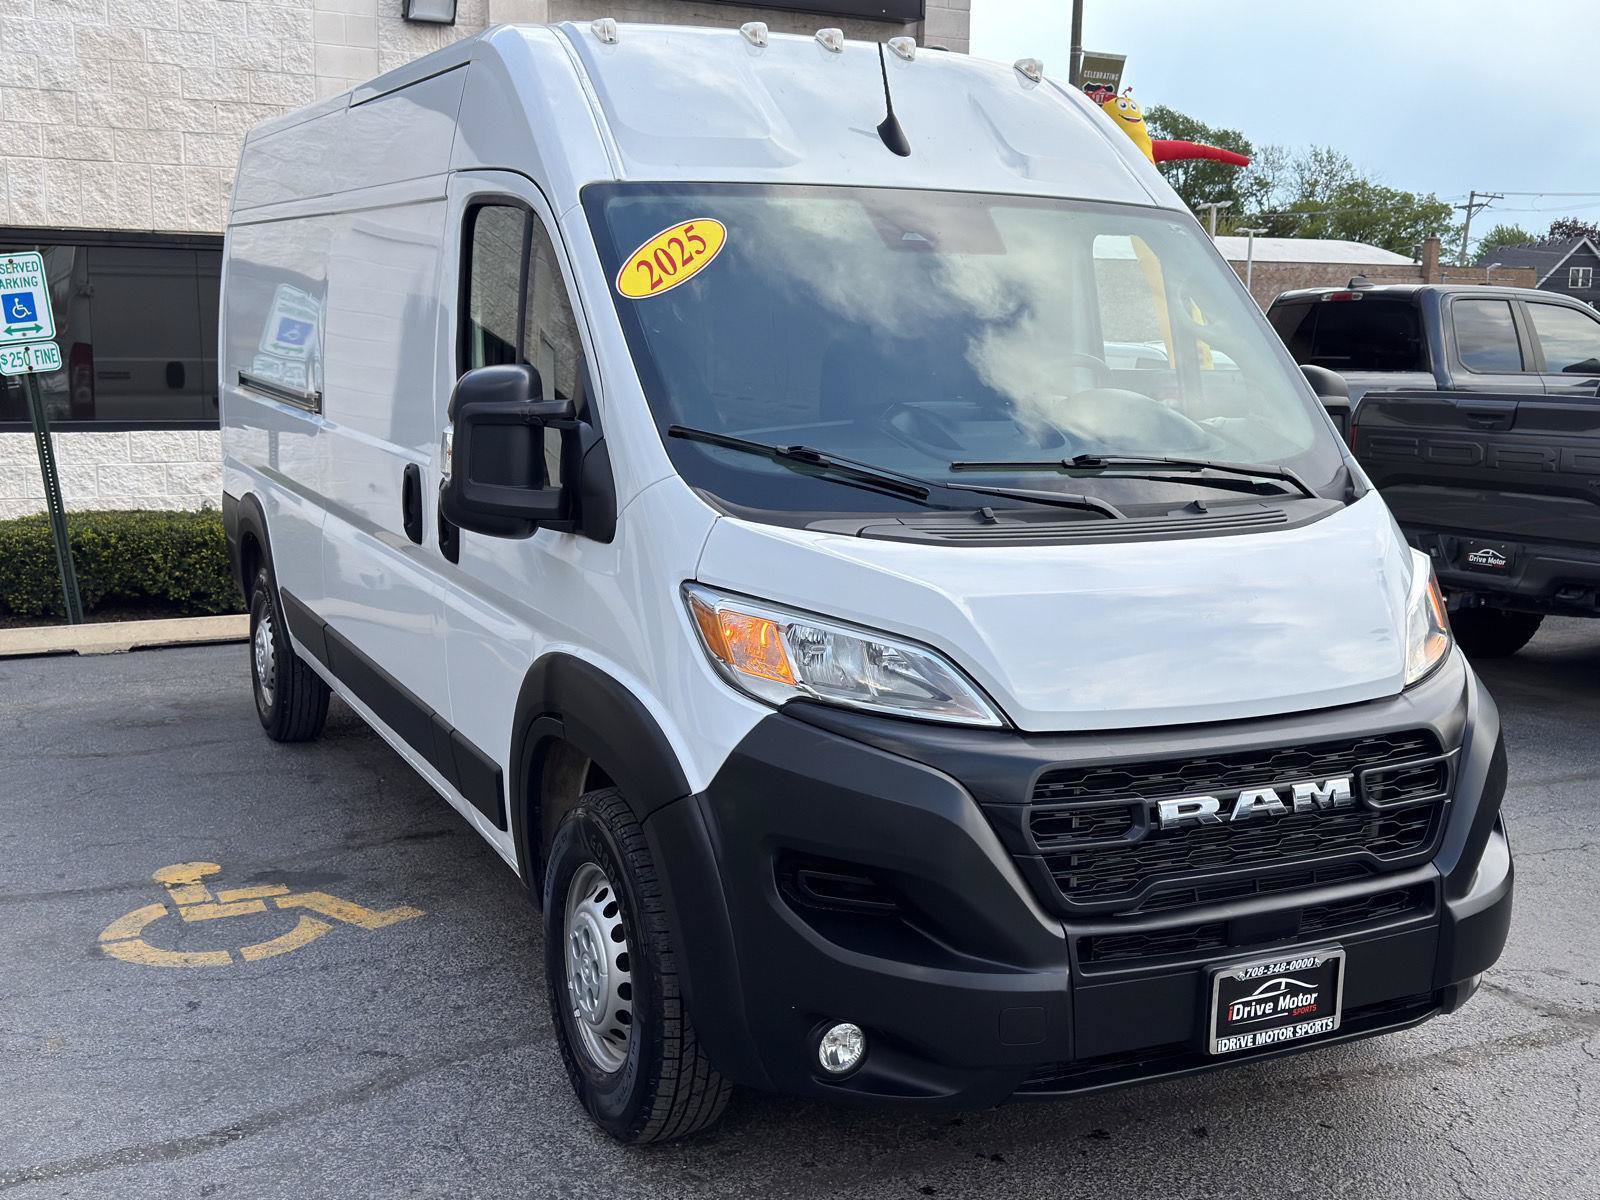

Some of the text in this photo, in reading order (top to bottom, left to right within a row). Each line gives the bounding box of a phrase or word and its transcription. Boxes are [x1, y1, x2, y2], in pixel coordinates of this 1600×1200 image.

[1084, 70, 1119, 80] CELEBRATING
[636, 225, 707, 291] 2025
[35, 348, 59, 365] FINE
[1487, 557, 1506, 566] Motor
[1155, 777, 1352, 830] RAM
[1246, 957, 1313, 977] 708-348-0000
[1227, 992, 1318, 1021] iDrive Motor
[1292, 1005, 1317, 1016] SPORTS
[1255, 1026, 1295, 1045] MOTOR
[1295, 1018, 1334, 1036] SPORTS
